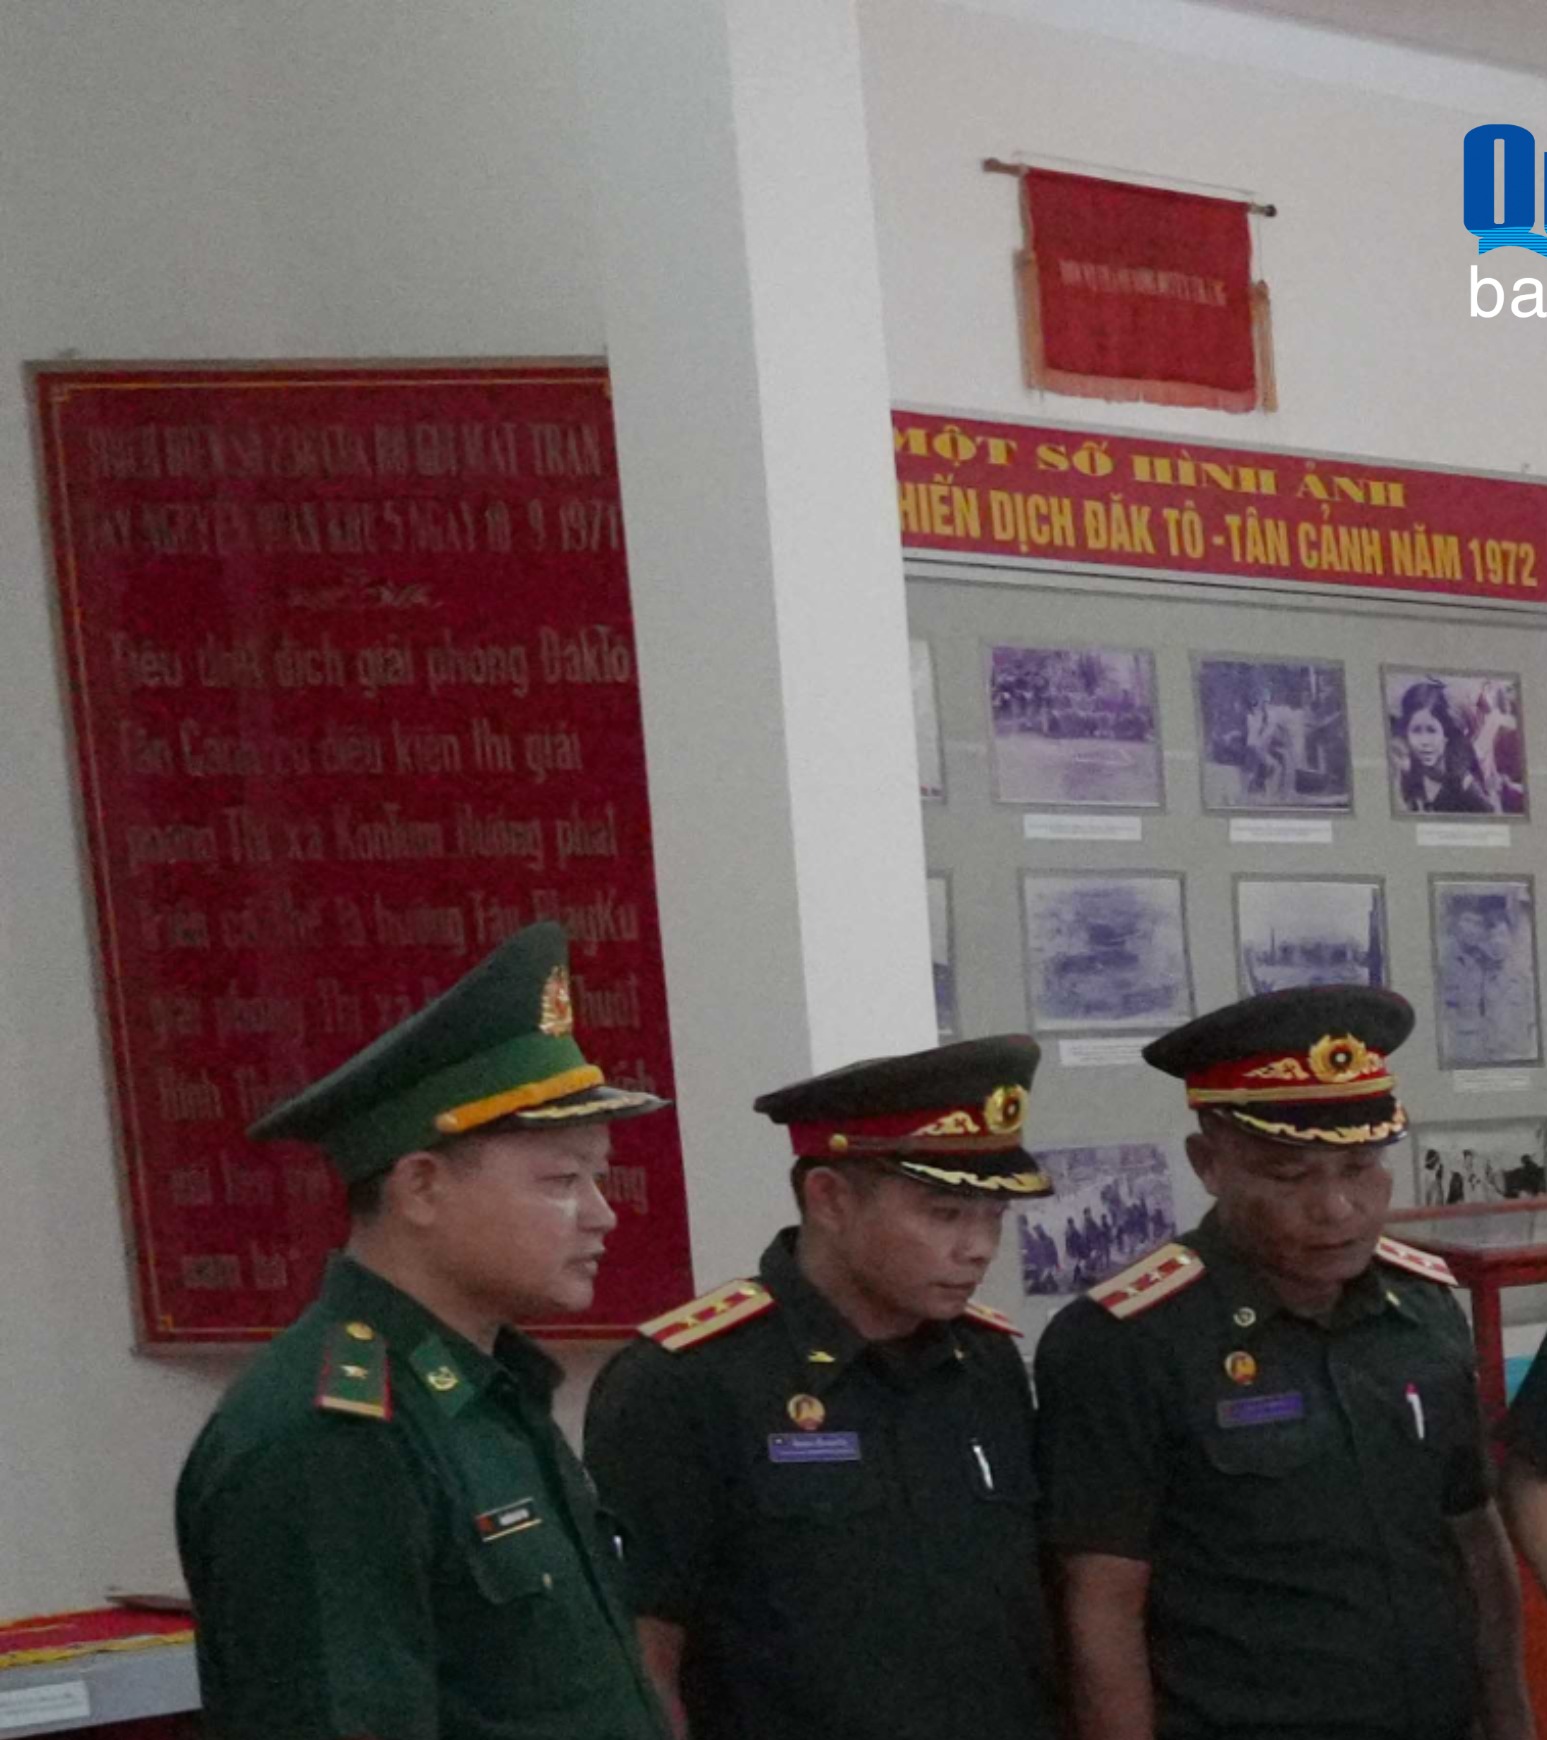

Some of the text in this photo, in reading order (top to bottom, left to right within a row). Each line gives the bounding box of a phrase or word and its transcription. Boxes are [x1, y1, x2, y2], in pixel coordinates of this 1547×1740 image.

[1035, 440, 1115, 478] SỐ
[1131, 449, 1277, 496] HÌNH
[1296, 460, 1406, 509] ẢNH
[898, 473, 981, 541] HIẾN
[989, 489, 1077, 555] DỊCH
[1162, 499, 1206, 561] TÔ
[1298, 503, 1386, 576] CẢNH
[1391, 522, 1464, 582] NĂM
[1468, 538, 1539, 589] 1972
